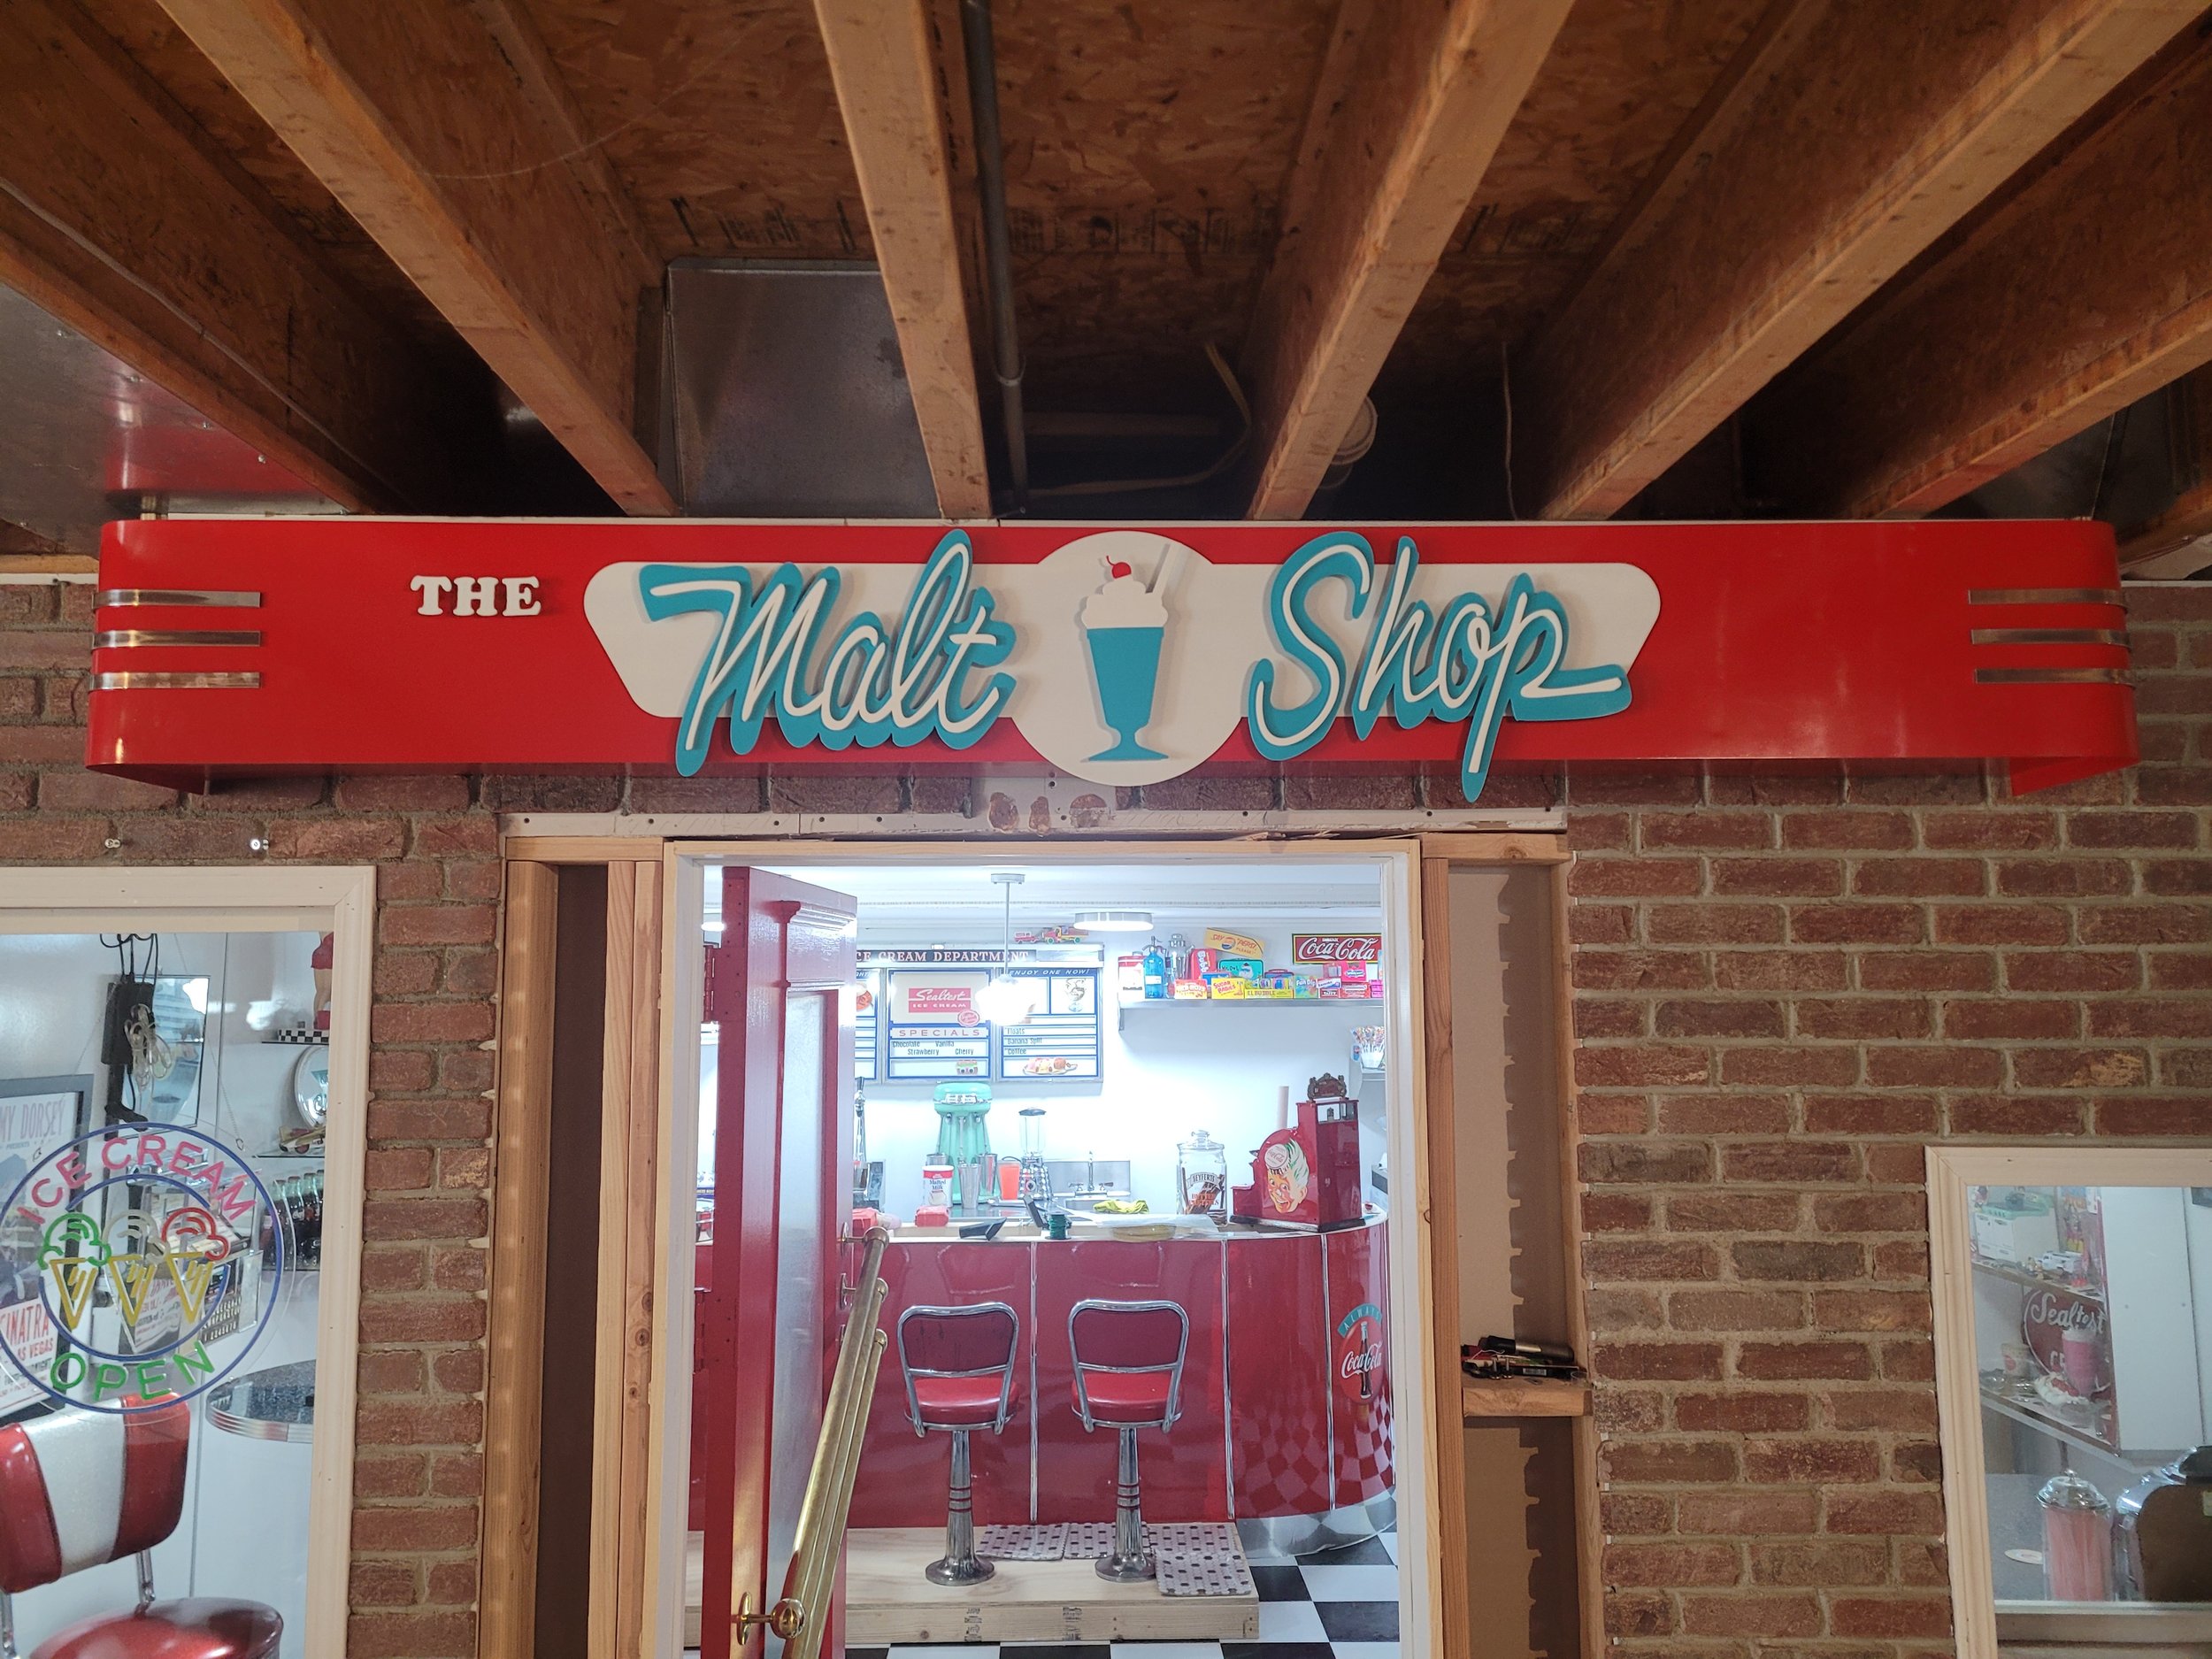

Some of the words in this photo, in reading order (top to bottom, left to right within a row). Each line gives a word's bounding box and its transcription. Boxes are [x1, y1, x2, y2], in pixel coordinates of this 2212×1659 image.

[410, 575, 541, 617] THE
[639, 528, 1017, 777] Malt
[1248, 531, 1632, 803] Shop
[879, 951, 927, 962] CREAM
[1298, 937, 1379, 961] Coca-Cola
[915, 988, 968, 1002] Sealtest
[1213, 980, 1231, 989] SUGAR
[1217, 985, 1236, 994] BABIES
[1307, 979, 1317, 987] Dip
[907, 1048, 940, 1056] Strawberry
[20, 1100, 66, 1140] DORSEY
[17, 1151, 92, 1225] ICE
[101, 1134, 257, 1223] CREAM
[1343, 1306, 1381, 1331] ALWAYS
[2031, 1292, 2107, 1334] Sealtest
[29, 1337, 54, 1359] VEGAS
[1341, 1340, 1383, 1379] Coca-Cola
[50, 1340, 215, 1402] OPEN
